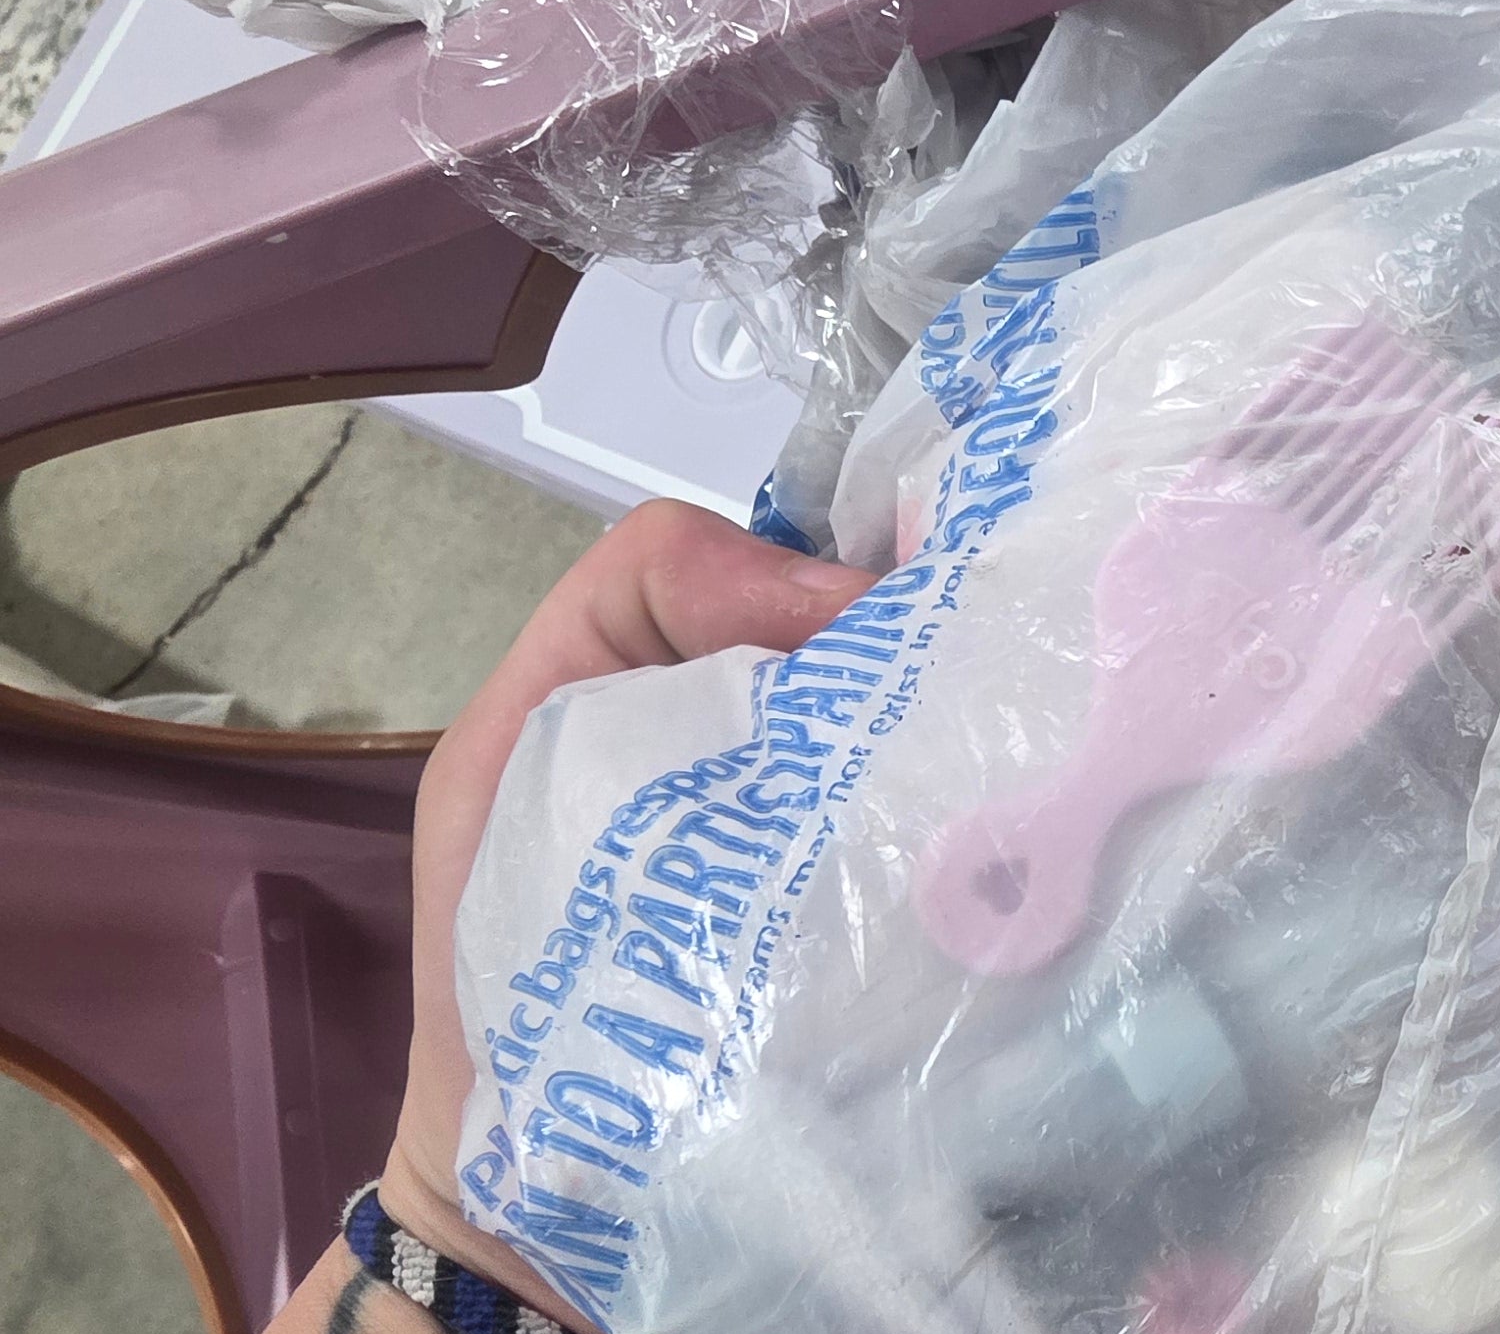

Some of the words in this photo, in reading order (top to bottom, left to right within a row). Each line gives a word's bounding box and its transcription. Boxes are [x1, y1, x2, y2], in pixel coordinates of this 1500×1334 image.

[784, 815, 837, 896] may
[826, 742, 874, 803] not
[868, 664, 922, 736] exist
[909, 623, 943, 651] in
[509, 859, 622, 1011] bags
[582, 1003, 705, 1081] A
[521, 1070, 657, 1189] TO
